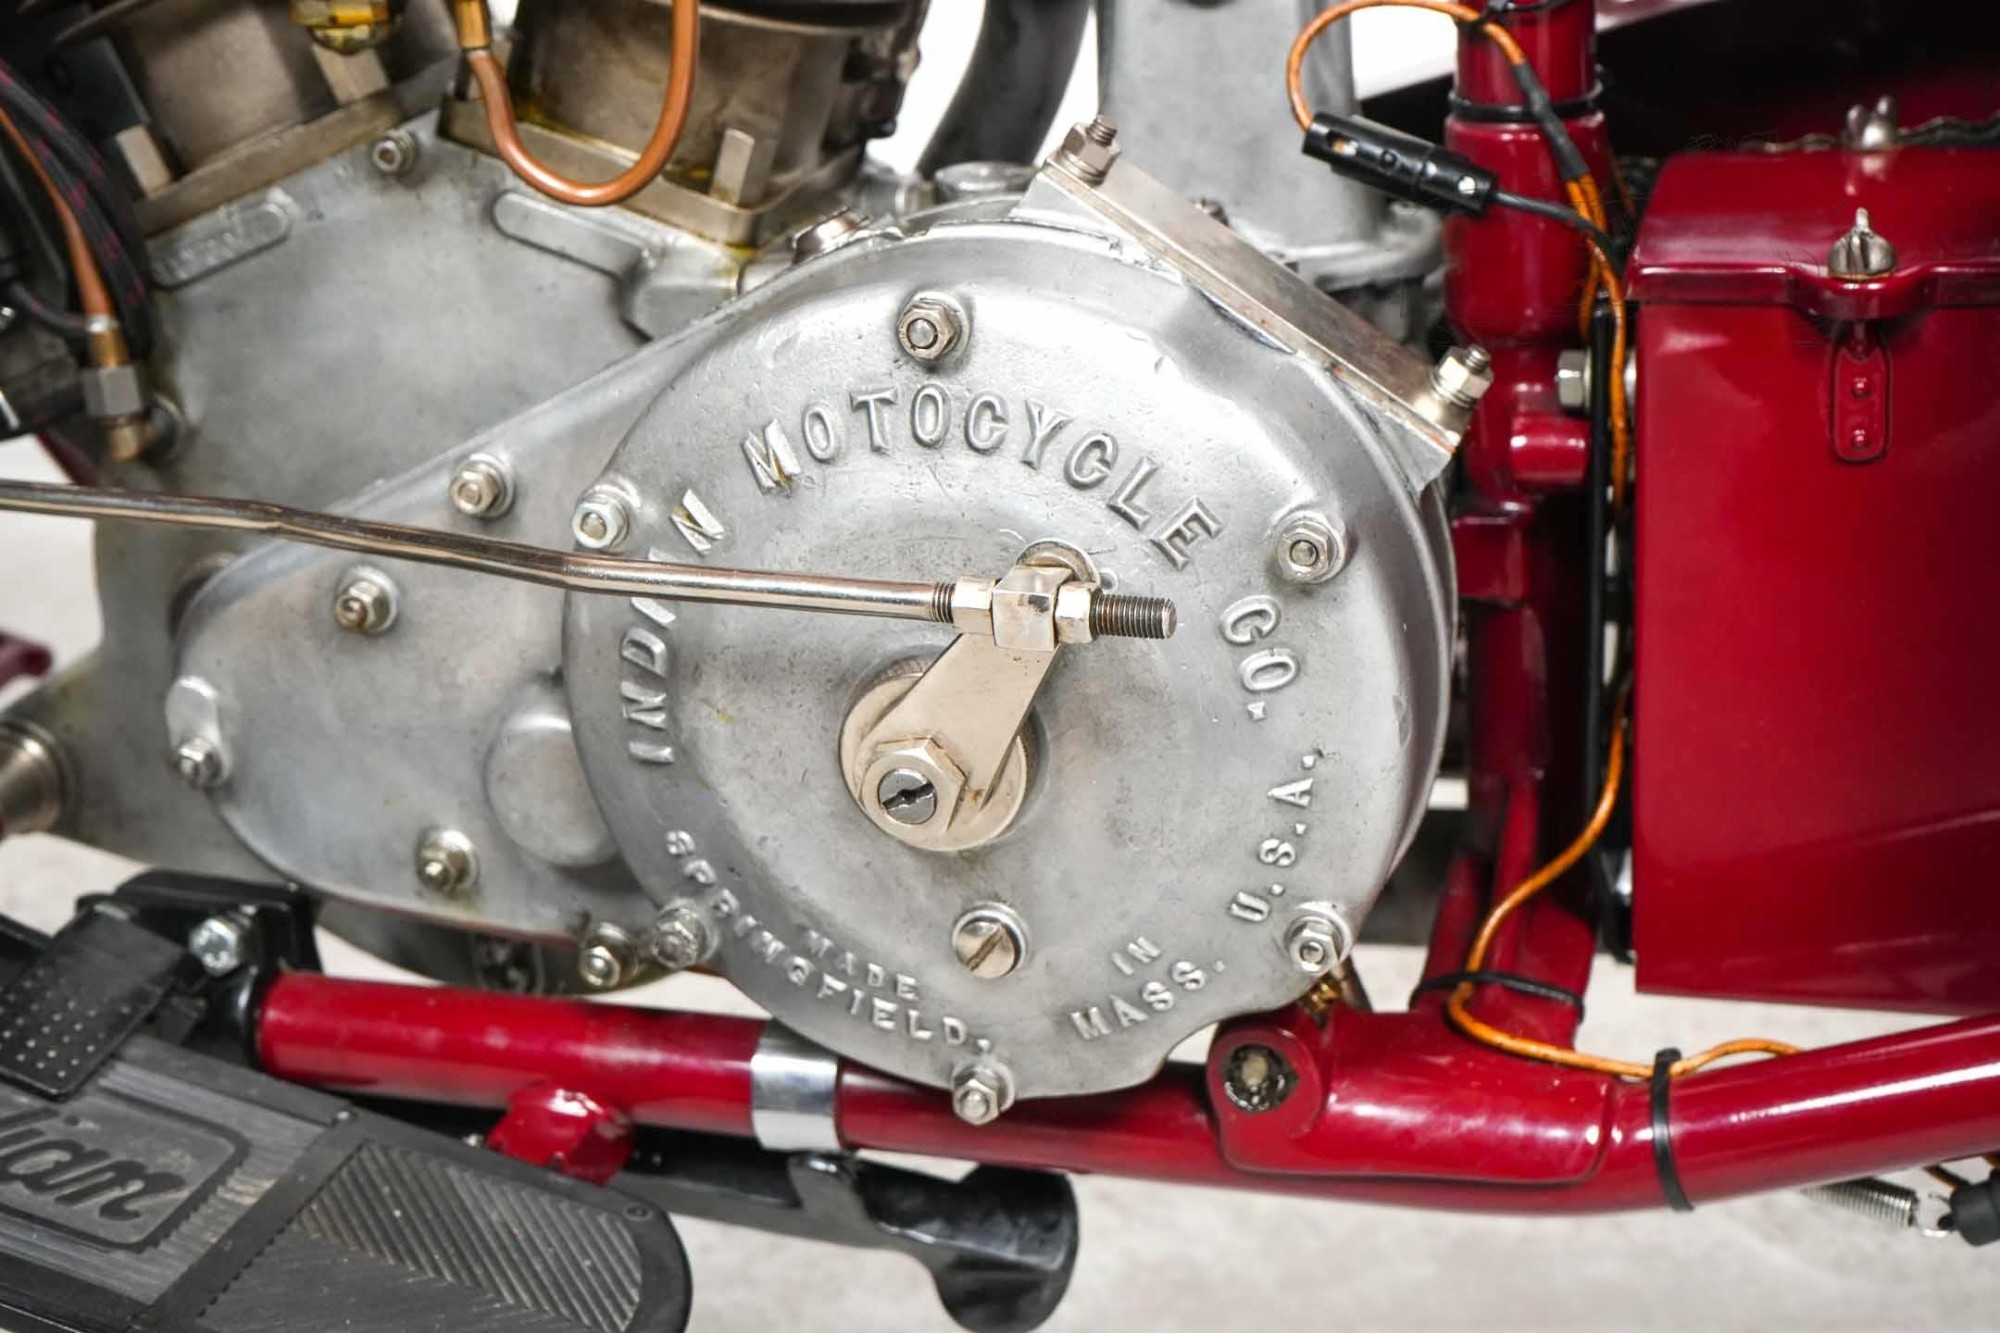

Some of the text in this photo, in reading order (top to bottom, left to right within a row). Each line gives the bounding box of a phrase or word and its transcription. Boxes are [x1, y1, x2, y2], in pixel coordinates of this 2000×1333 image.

[620, 382, 1301, 764] INDIN MOTOCYCLE CO.
[807, 929, 1163, 1000] MADE IN
[1069, 960, 1227, 1040] MASS.
[1229, 754, 1315, 923] U.S.A.
